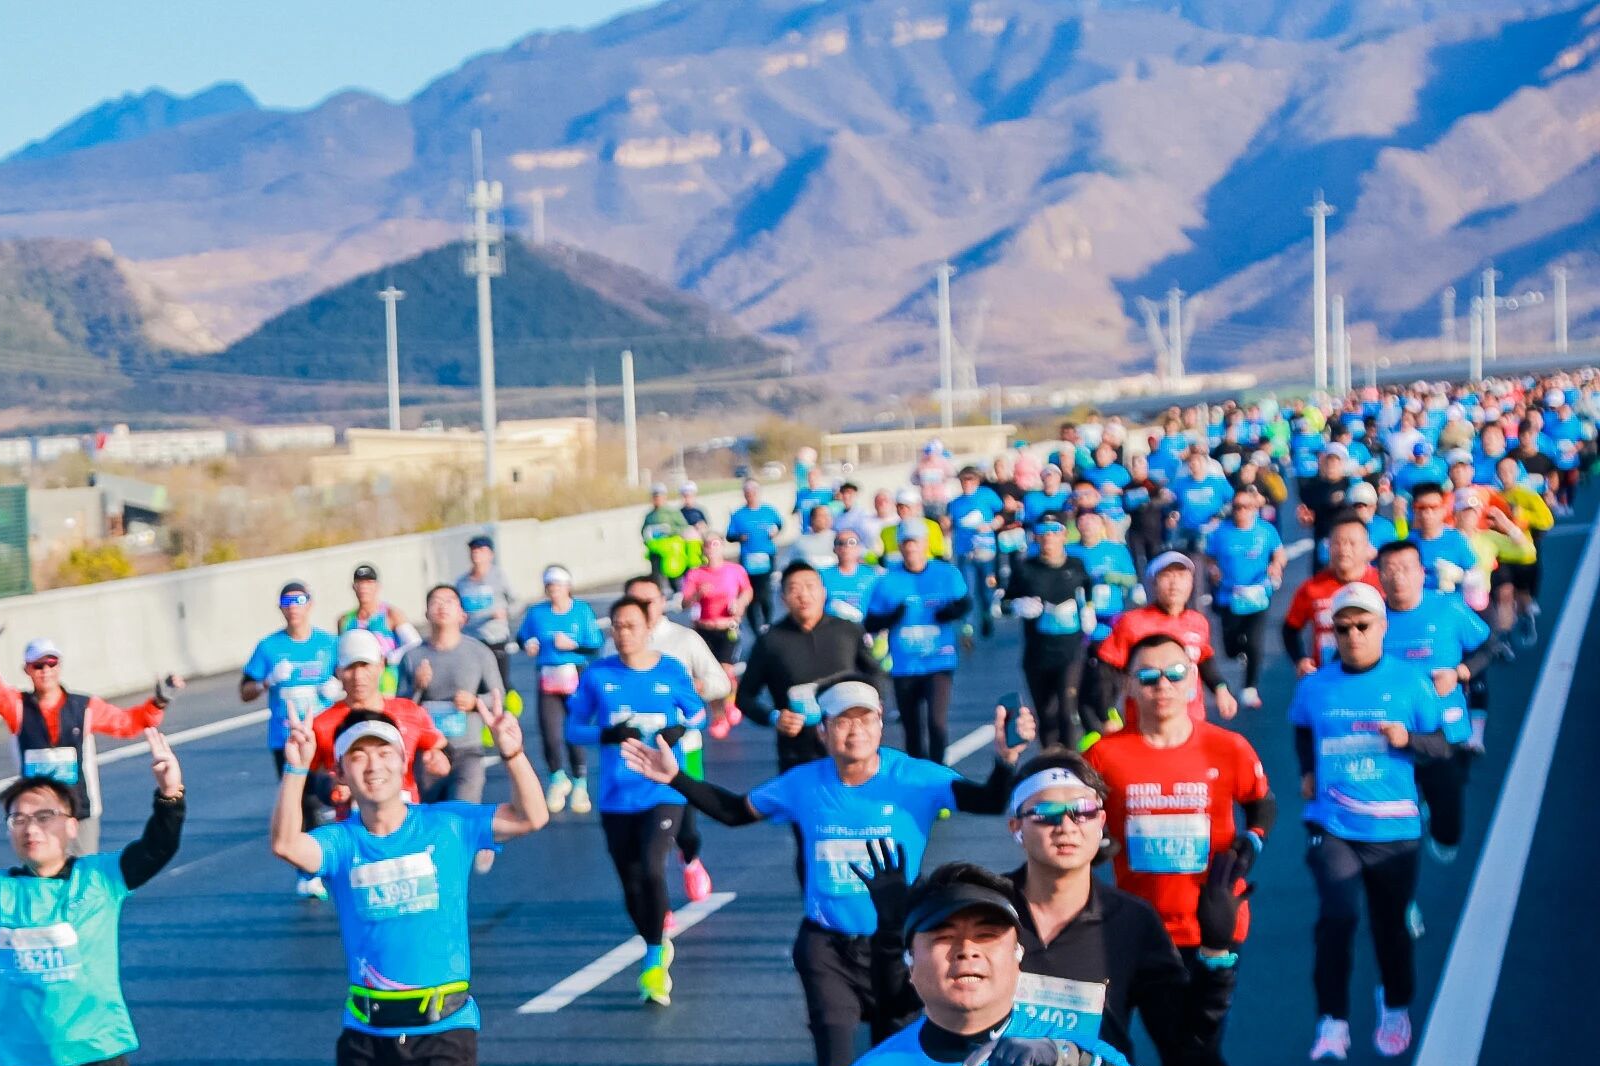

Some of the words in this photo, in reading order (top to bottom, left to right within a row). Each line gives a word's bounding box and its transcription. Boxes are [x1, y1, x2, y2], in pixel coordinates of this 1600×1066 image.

[1126, 784, 1161, 796] RUN
[1173, 782, 1208, 795] FOR
[1126, 795, 1208, 809] KINDNESS
